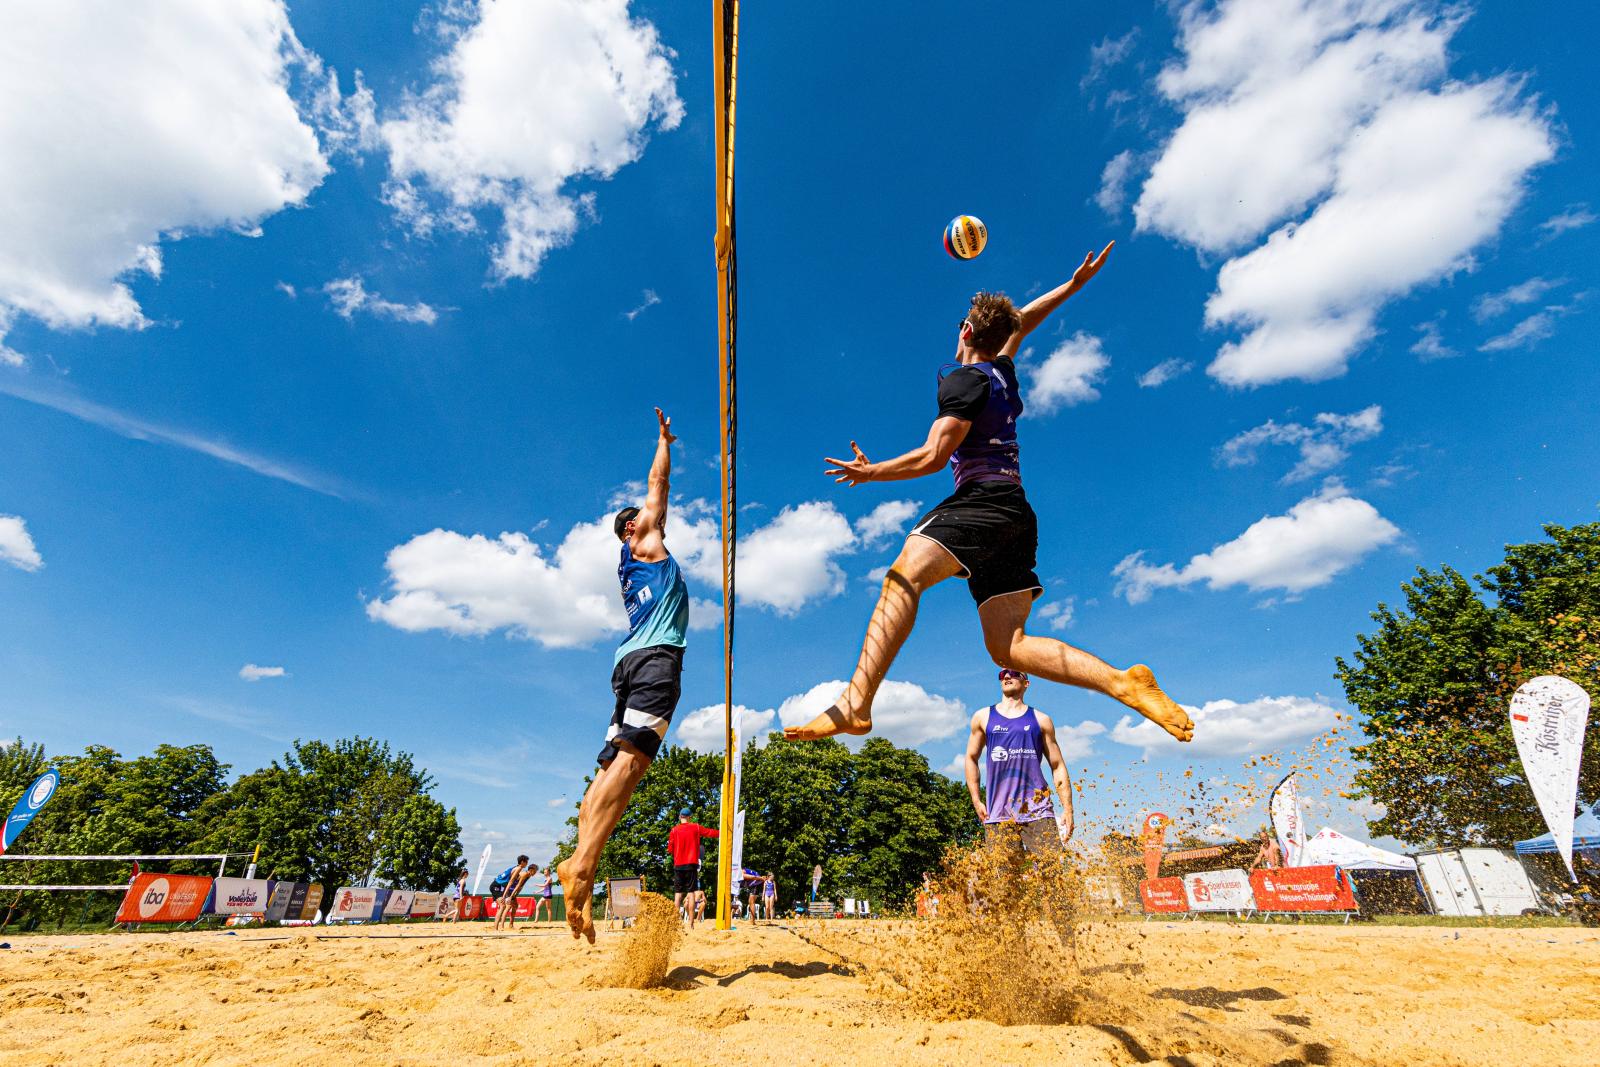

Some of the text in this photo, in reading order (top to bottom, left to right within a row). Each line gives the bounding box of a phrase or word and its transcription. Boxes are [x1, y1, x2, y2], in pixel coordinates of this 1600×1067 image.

[966, 221, 978, 251] MIKASA
[957, 238, 966, 254] BEACH
[144, 888, 165, 904] iba
[228, 895, 258, 903] Volleyball
